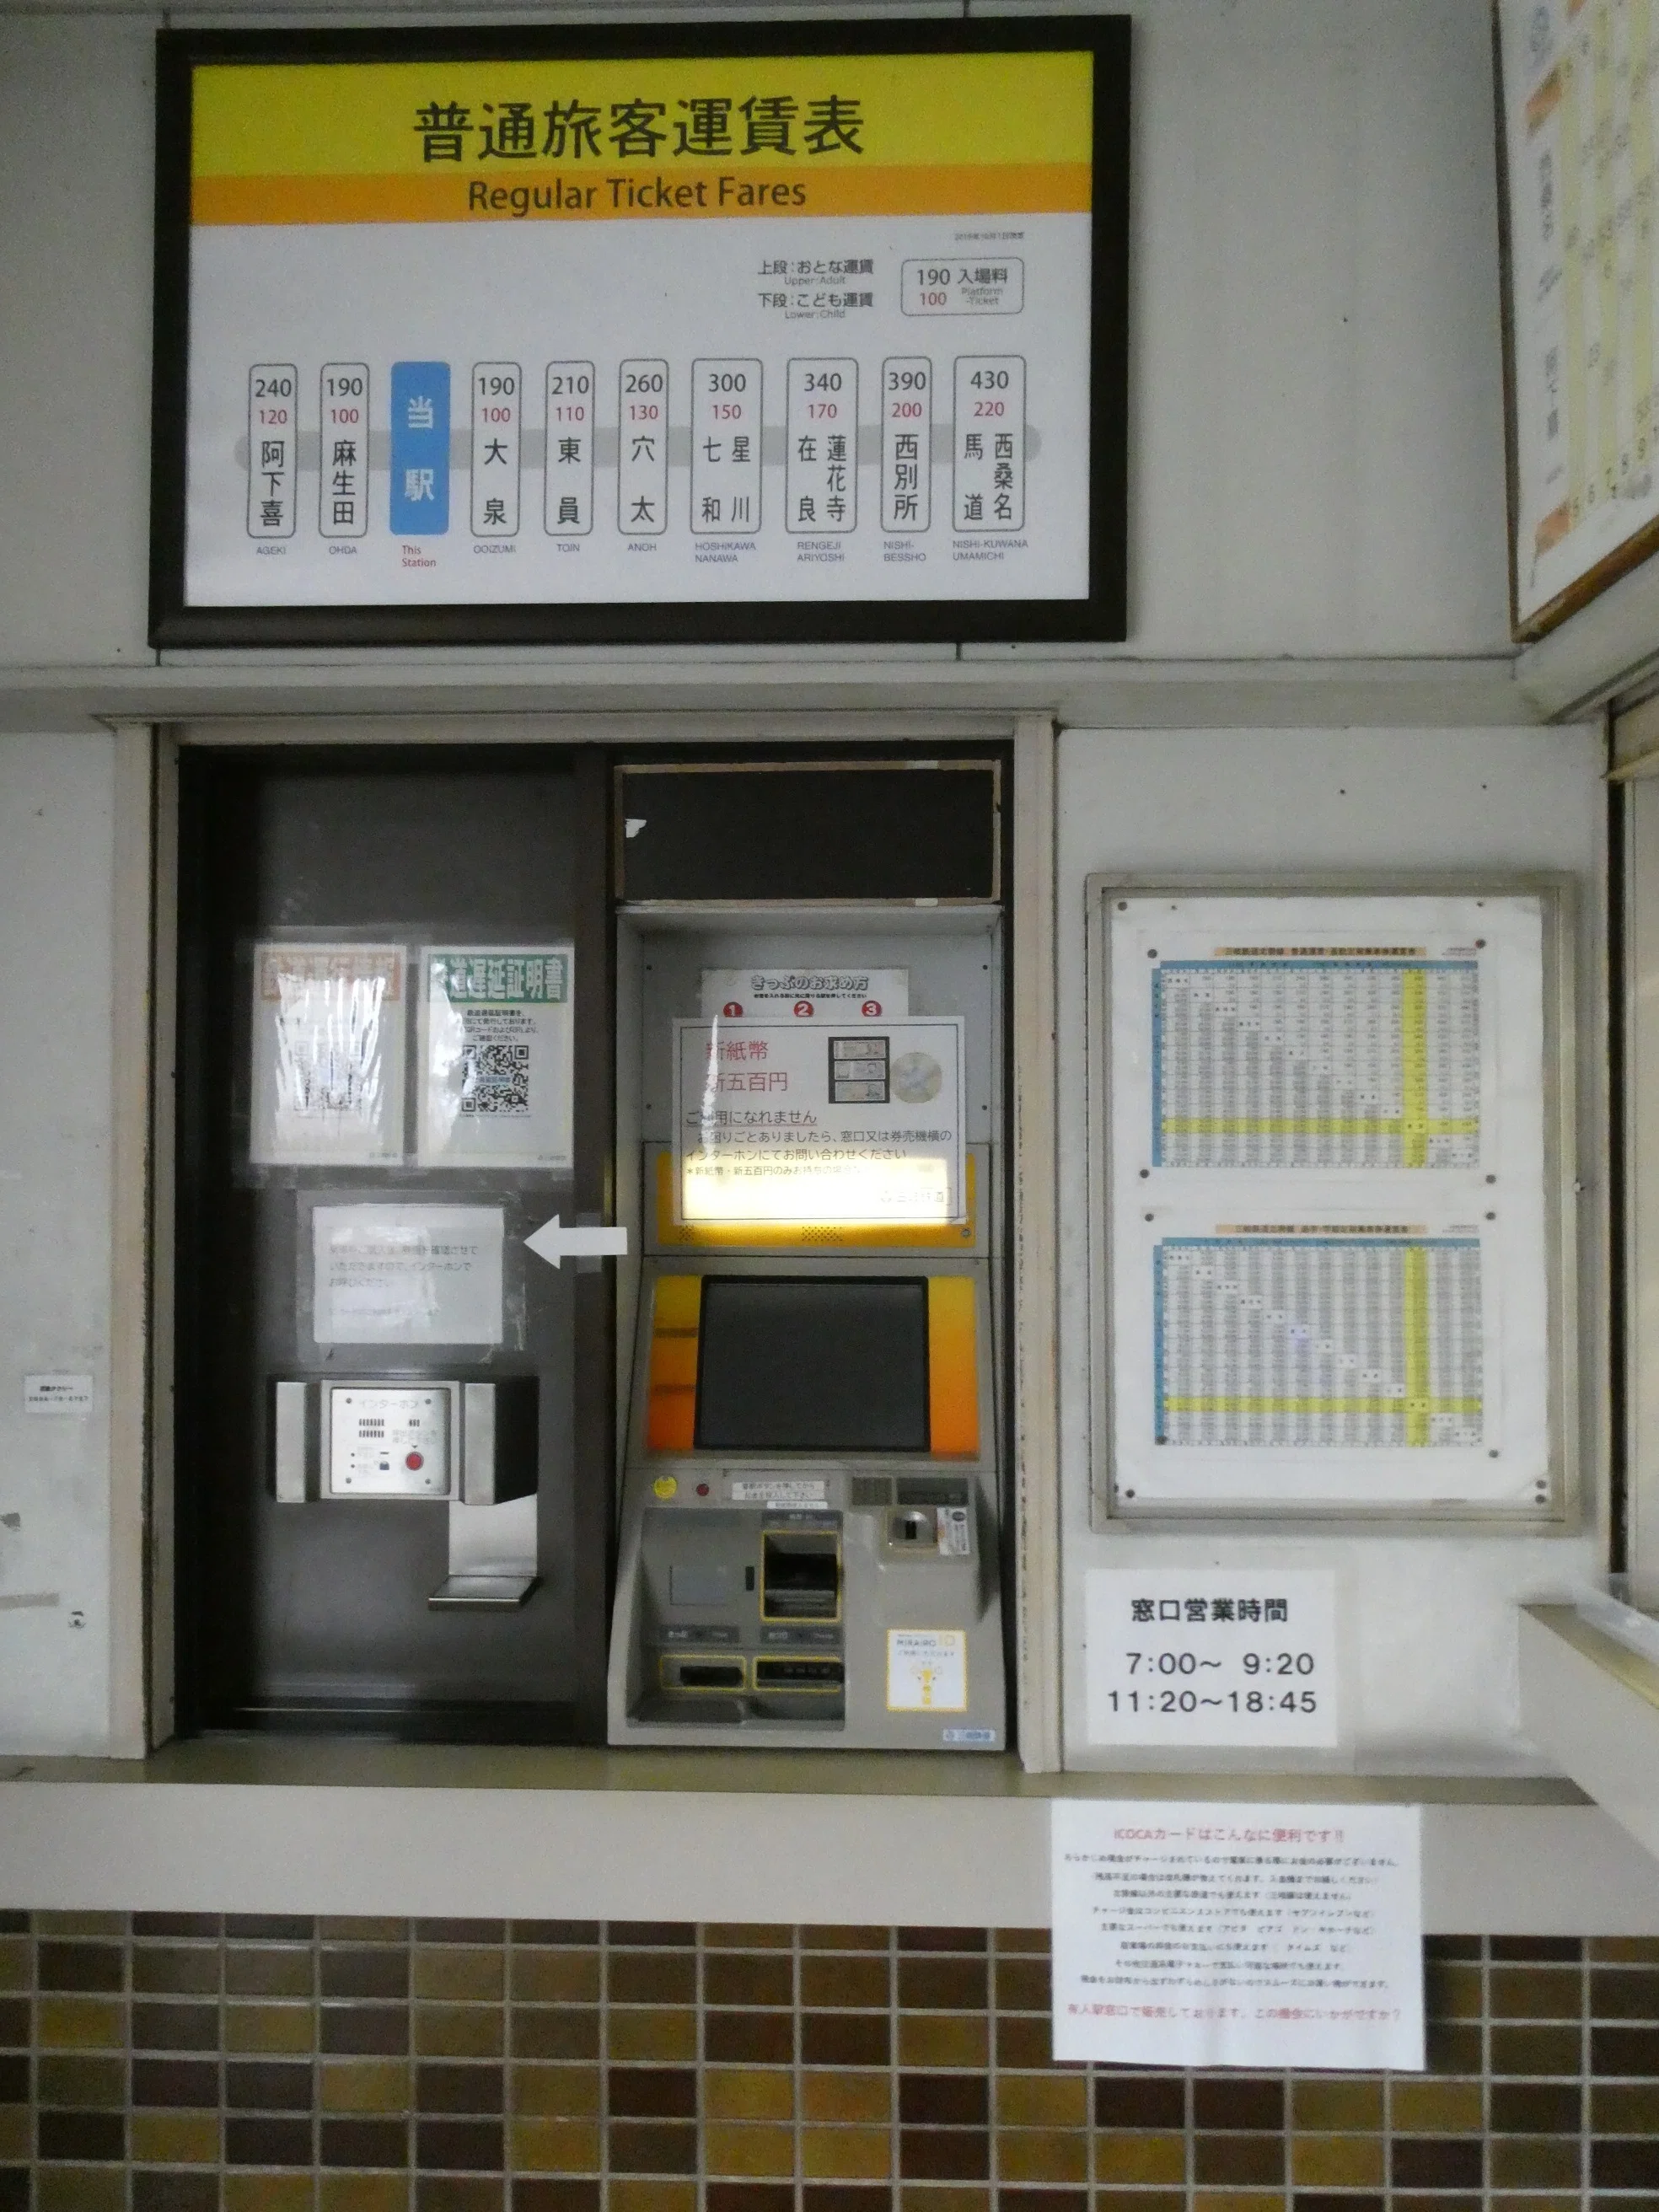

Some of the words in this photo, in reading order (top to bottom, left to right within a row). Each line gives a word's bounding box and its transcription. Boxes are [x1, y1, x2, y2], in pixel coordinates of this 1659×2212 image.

[414, 94, 864, 164] 普通旅客運賃表
[470, 178, 595, 217] Regular
[607, 176, 707, 208] Ticket
[719, 175, 807, 207] Fares
[917, 269, 951, 286] 190
[958, 267, 1008, 284] 入場料
[920, 292, 948, 306] 100
[255, 379, 293, 397] 240
[327, 378, 363, 397] 190
[479, 377, 515, 395] 190
[552, 376, 590, 395] 210
[625, 374, 663, 393] 260
[708, 373, 747, 392] 300
[804, 373, 842, 392] 340
[889, 372, 926, 390] 390
[970, 371, 1010, 389] 430
[260, 409, 288, 424] 120
[330, 408, 359, 423] 100
[481, 407, 512, 422] 100
[556, 406, 585, 421] 110
[631, 405, 659, 420] 130
[713, 405, 742, 420] 150
[808, 403, 838, 418] 170
[891, 402, 922, 417] 200
[974, 401, 1005, 416] 220
[405, 395, 435, 502] 当駅
[260, 440, 285, 526] 阿下喜
[332, 439, 357, 525] 麻生田
[483, 438, 508, 525] 大泉
[557, 437, 582, 524] 東員
[631, 436, 655, 522] 穴太
[702, 436, 722, 523] 七和
[732, 436, 751, 523] 星川
[797, 435, 817, 523] 在良
[827, 435, 847, 523] 蓮花寺
[894, 434, 919, 521] 西別所
[964, 433, 984, 520] 馬道
[994, 432, 1013, 520] 西桑名
[255, 545, 287, 555] AGEKI
[402, 545, 421, 555] This
[695, 542, 756, 550] HOSHIKAWA
[797, 541, 841, 550] RENGEJI
[402, 558, 437, 567] Station
[695, 554, 738, 562] NANAWA
[797, 553, 844, 562] ARIYOSHI
[883, 553, 926, 561] BESSHO
[953, 552, 1004, 561] UMAMICHI
[750, 974, 870, 991] きっぷのお求め方
[686, 1109, 818, 1125] ご用になれません
[1131, 1597, 1288, 1623] 窓口営業時間
[1125, 1652, 1221, 1675] 7:00～
[1243, 1652, 1314, 1676] 9:20
